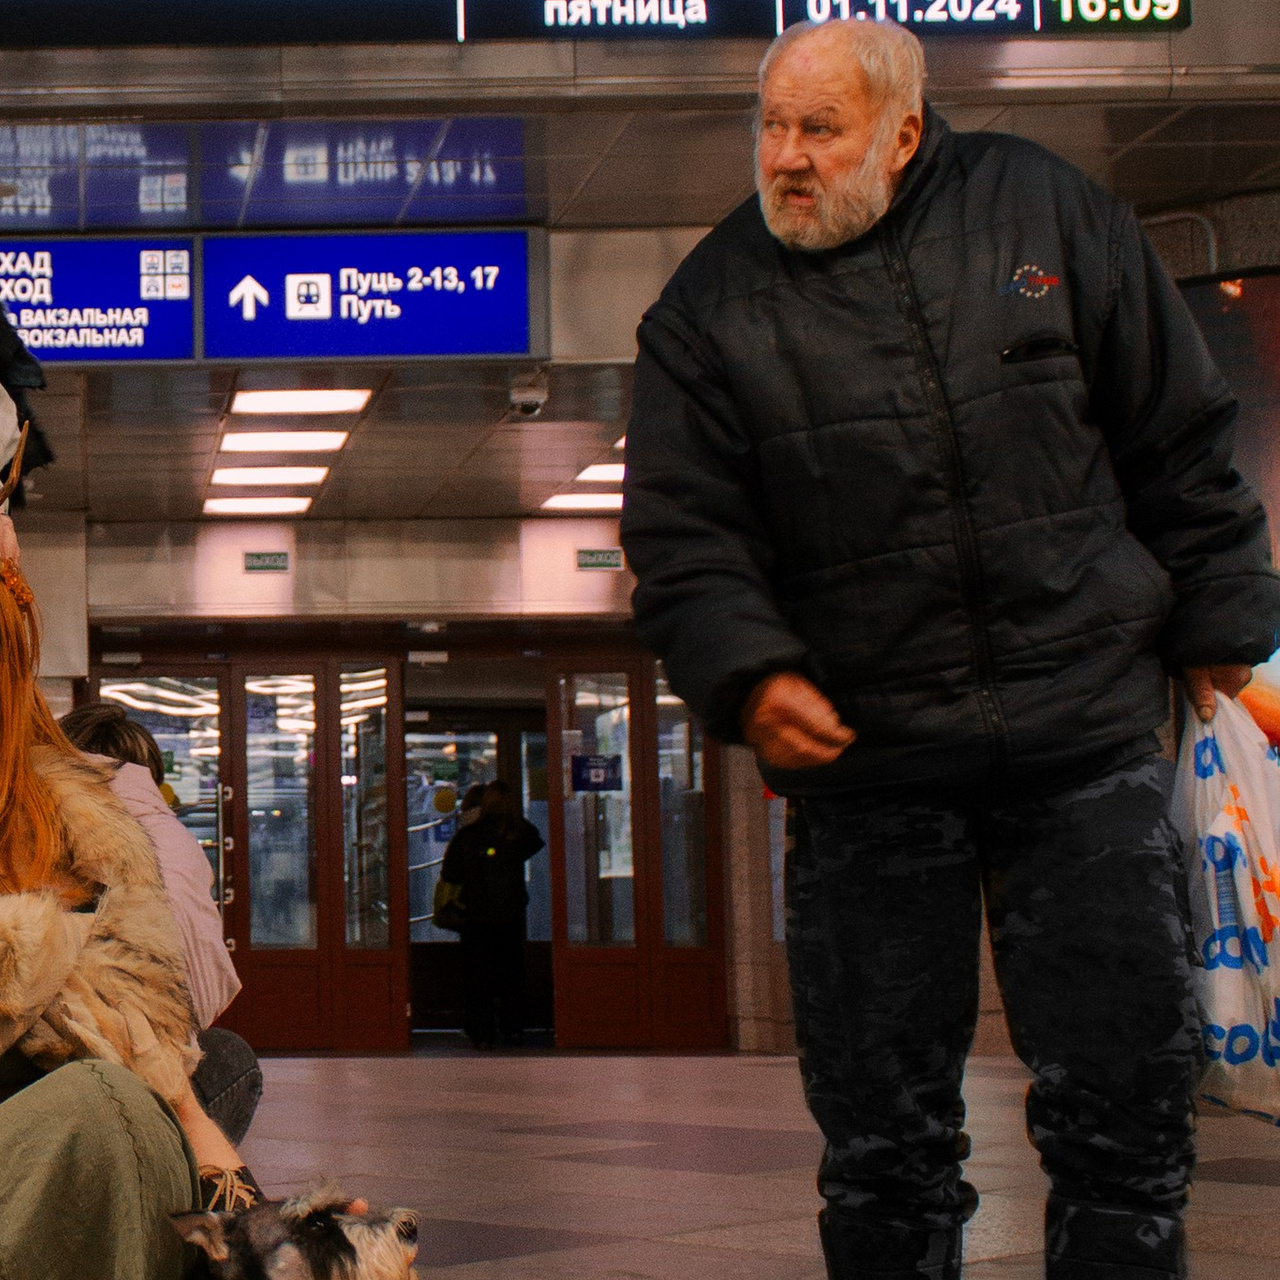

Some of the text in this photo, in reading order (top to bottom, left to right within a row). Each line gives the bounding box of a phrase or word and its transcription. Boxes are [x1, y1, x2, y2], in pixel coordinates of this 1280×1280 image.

[339, 266, 500, 294] Пуць 2-13, 17
[20, 307, 149, 327] ВАКЗАЛЬНАЯ
[339, 295, 402, 324] Путь
